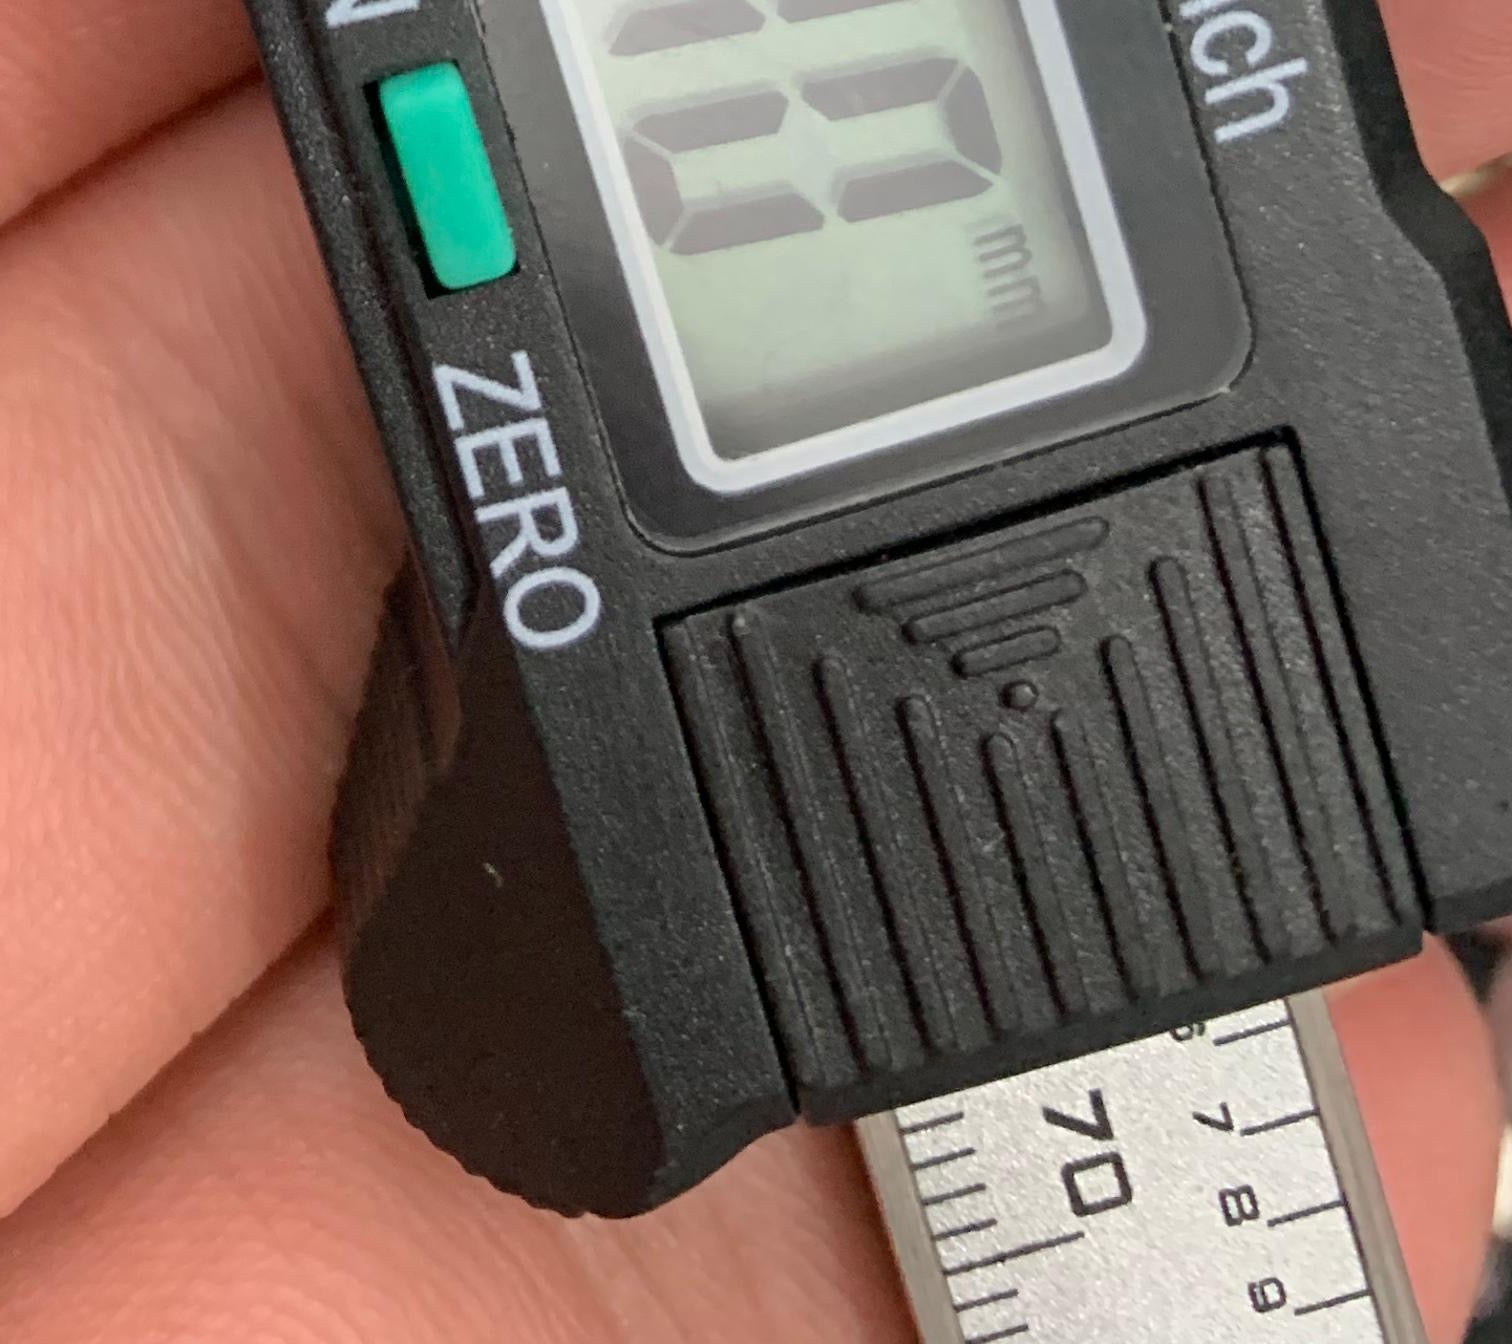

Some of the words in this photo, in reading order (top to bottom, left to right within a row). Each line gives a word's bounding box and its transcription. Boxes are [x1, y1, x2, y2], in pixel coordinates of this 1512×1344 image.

[973, 222, 1050, 332] mm
[433, 350, 601, 649] ZERO
[1042, 1088, 1133, 1218] 70
[1192, 1101, 1235, 1132] 7
[1218, 1184, 1261, 1228] 8
[1247, 1276, 1288, 1315] 9
